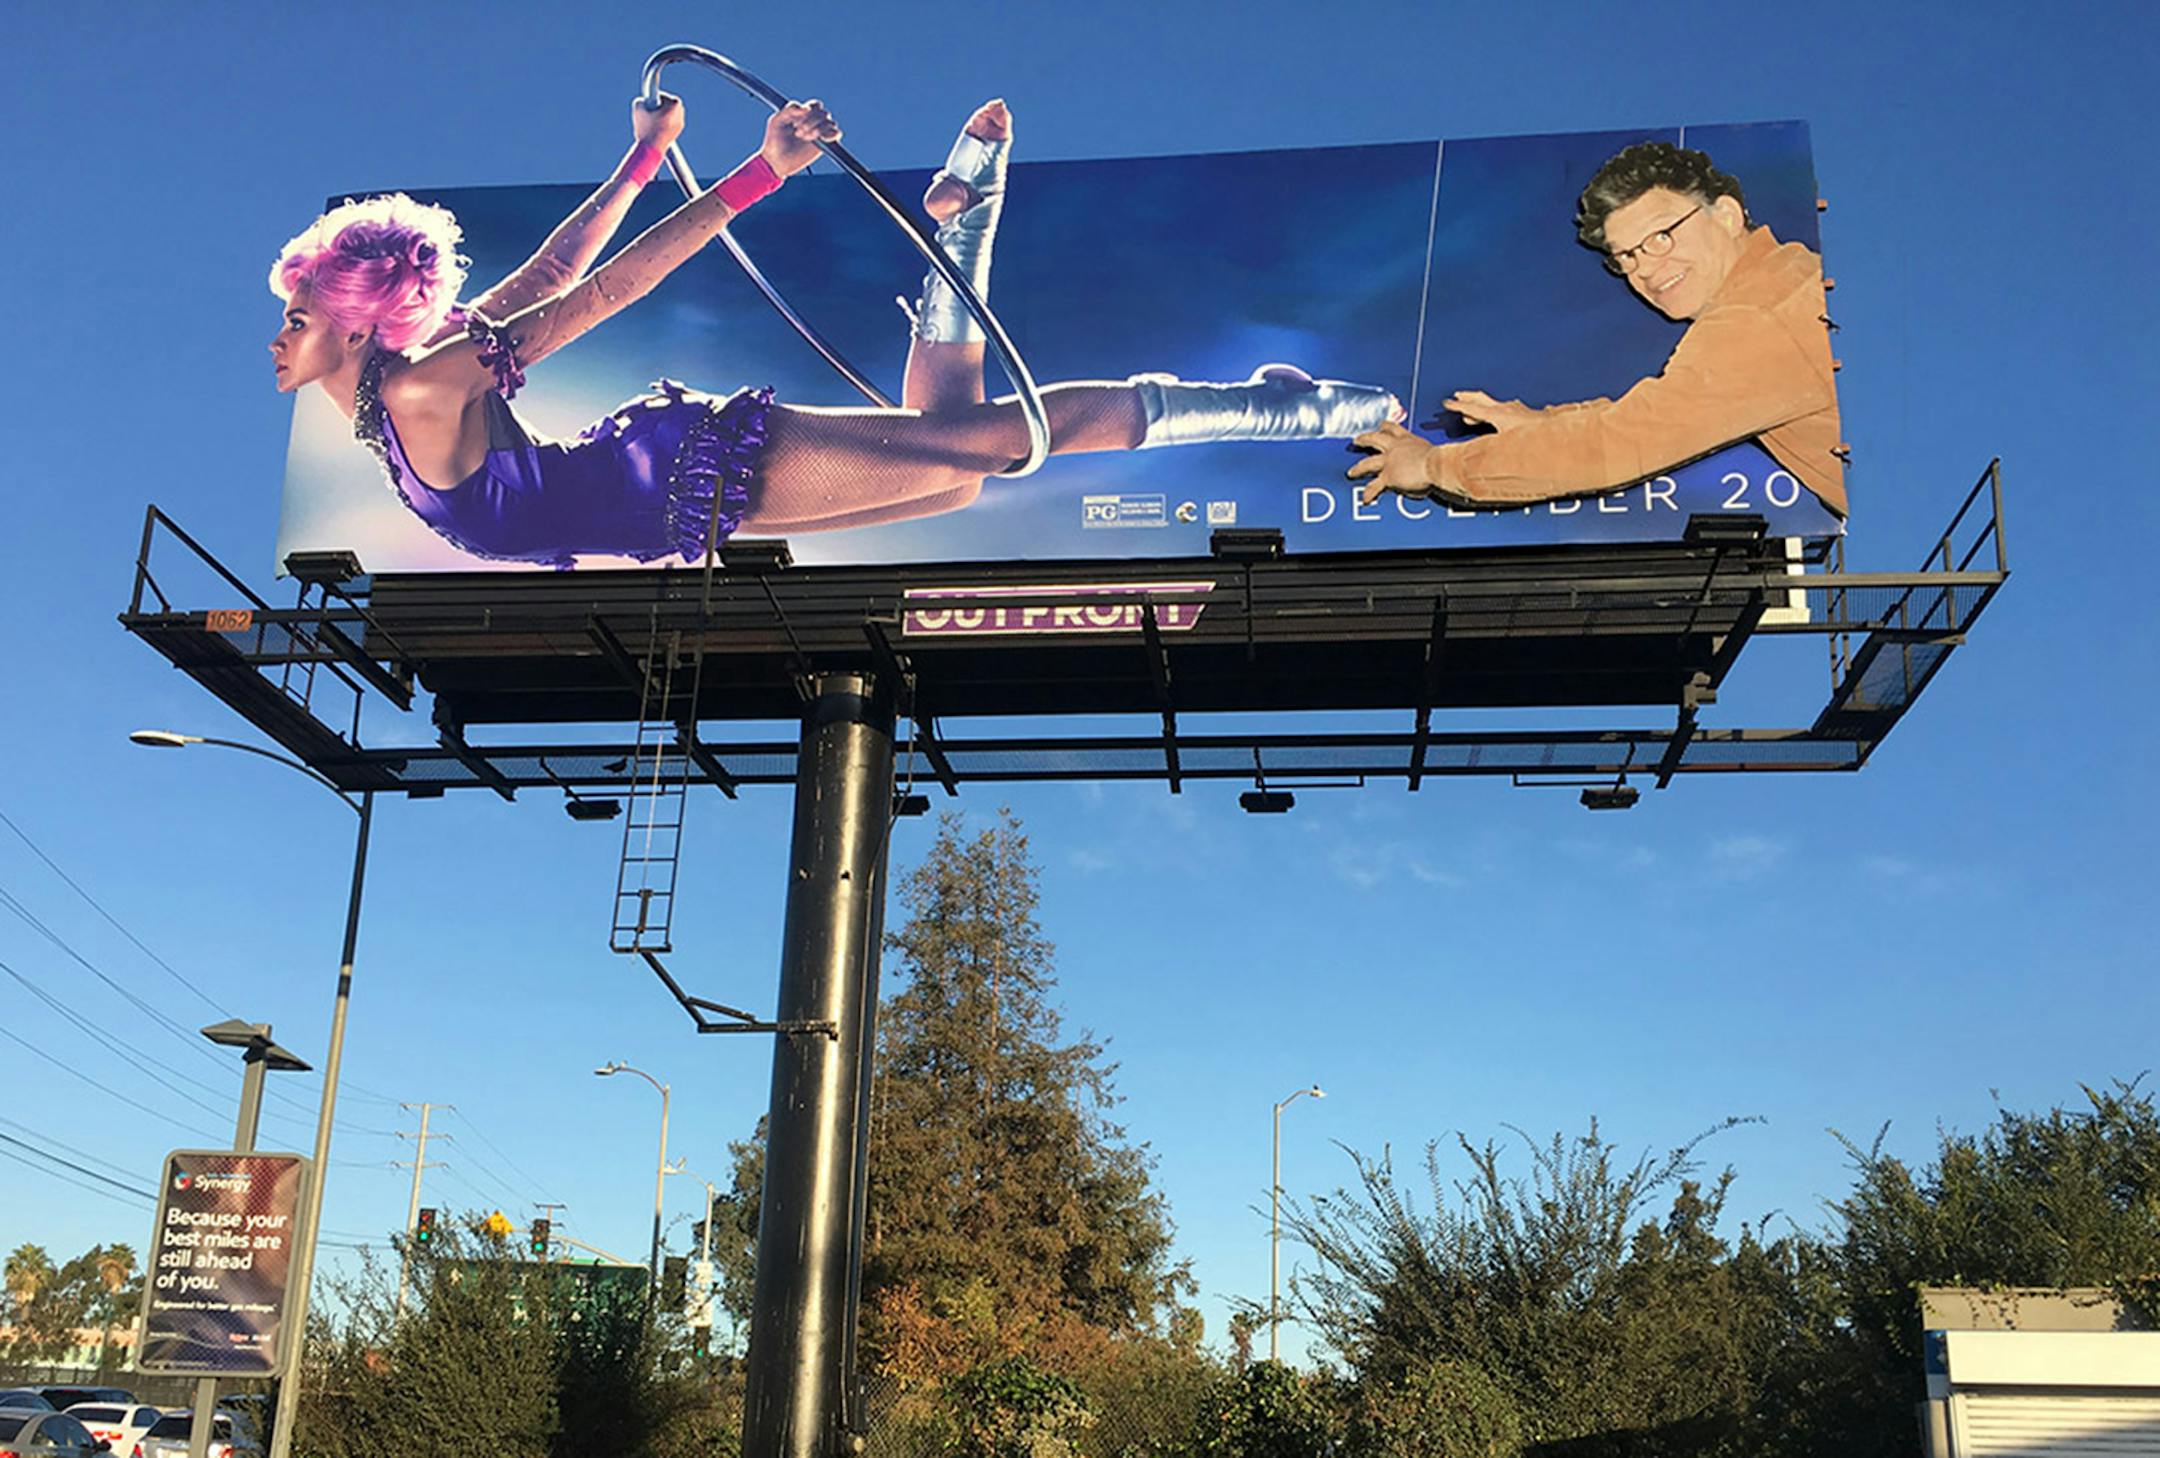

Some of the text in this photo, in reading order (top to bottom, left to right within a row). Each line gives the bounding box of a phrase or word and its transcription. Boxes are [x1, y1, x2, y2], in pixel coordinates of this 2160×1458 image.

[1301, 471, 1800, 523] DECER 20
[1086, 506, 1117, 521] PG
[194, 1174, 252, 1194] Synergy
[167, 1208, 287, 1232] Because your
[163, 1228, 282, 1249] best miles are
[159, 1250, 253, 1270] still ahead
[156, 1270, 220, 1293] of you.
